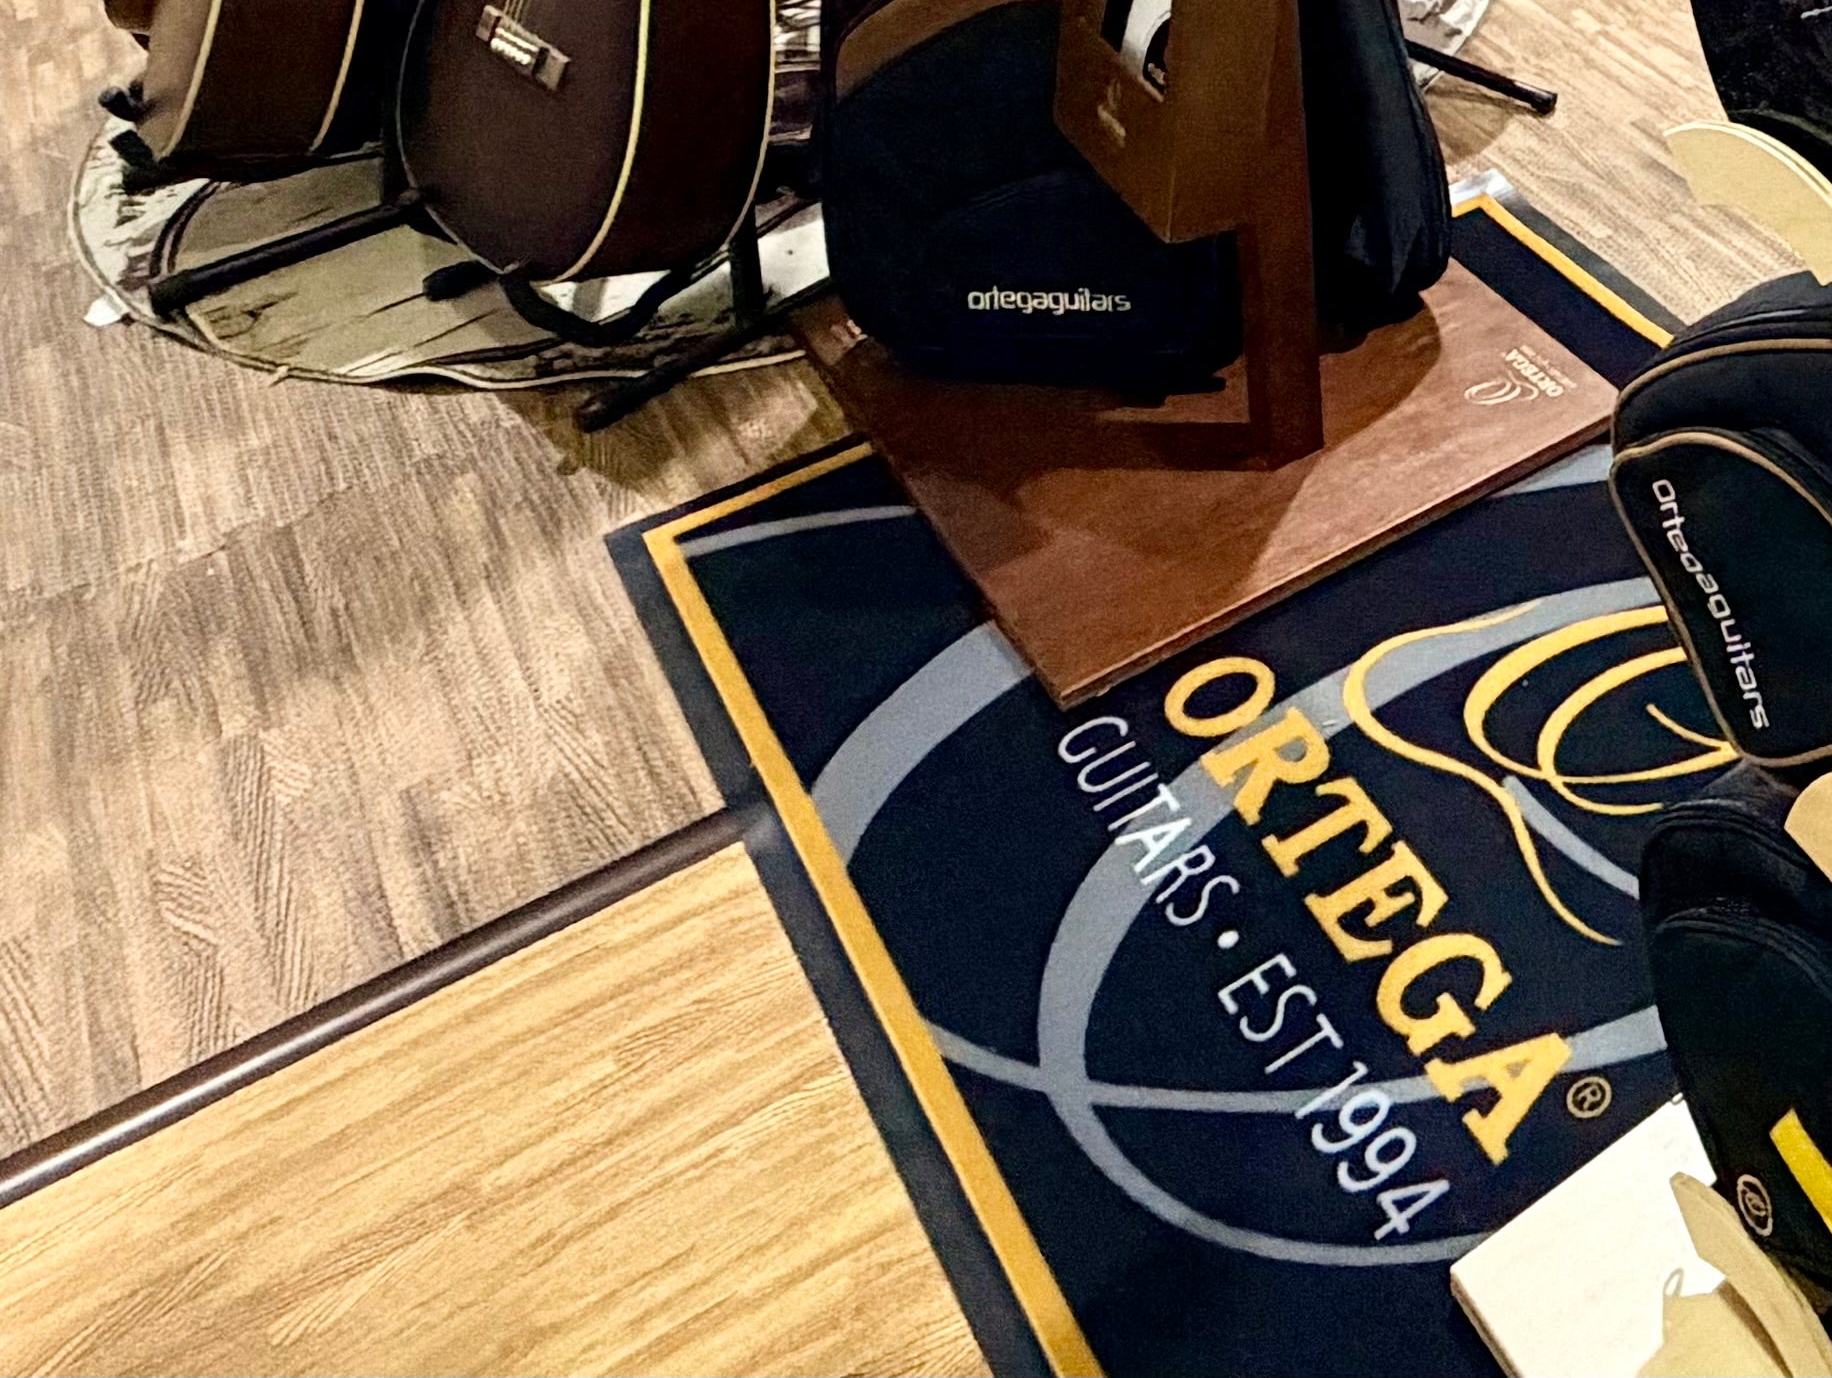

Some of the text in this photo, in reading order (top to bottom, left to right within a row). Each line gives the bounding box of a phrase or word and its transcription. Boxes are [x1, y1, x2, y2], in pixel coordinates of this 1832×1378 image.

[967, 284, 1132, 316] ortegaguitars
[1651, 478, 1770, 730] ortegaguitars
[1056, 715, 1450, 1241] GUITARS EST 1994
[1163, 655, 1572, 1165] ORTEGA
